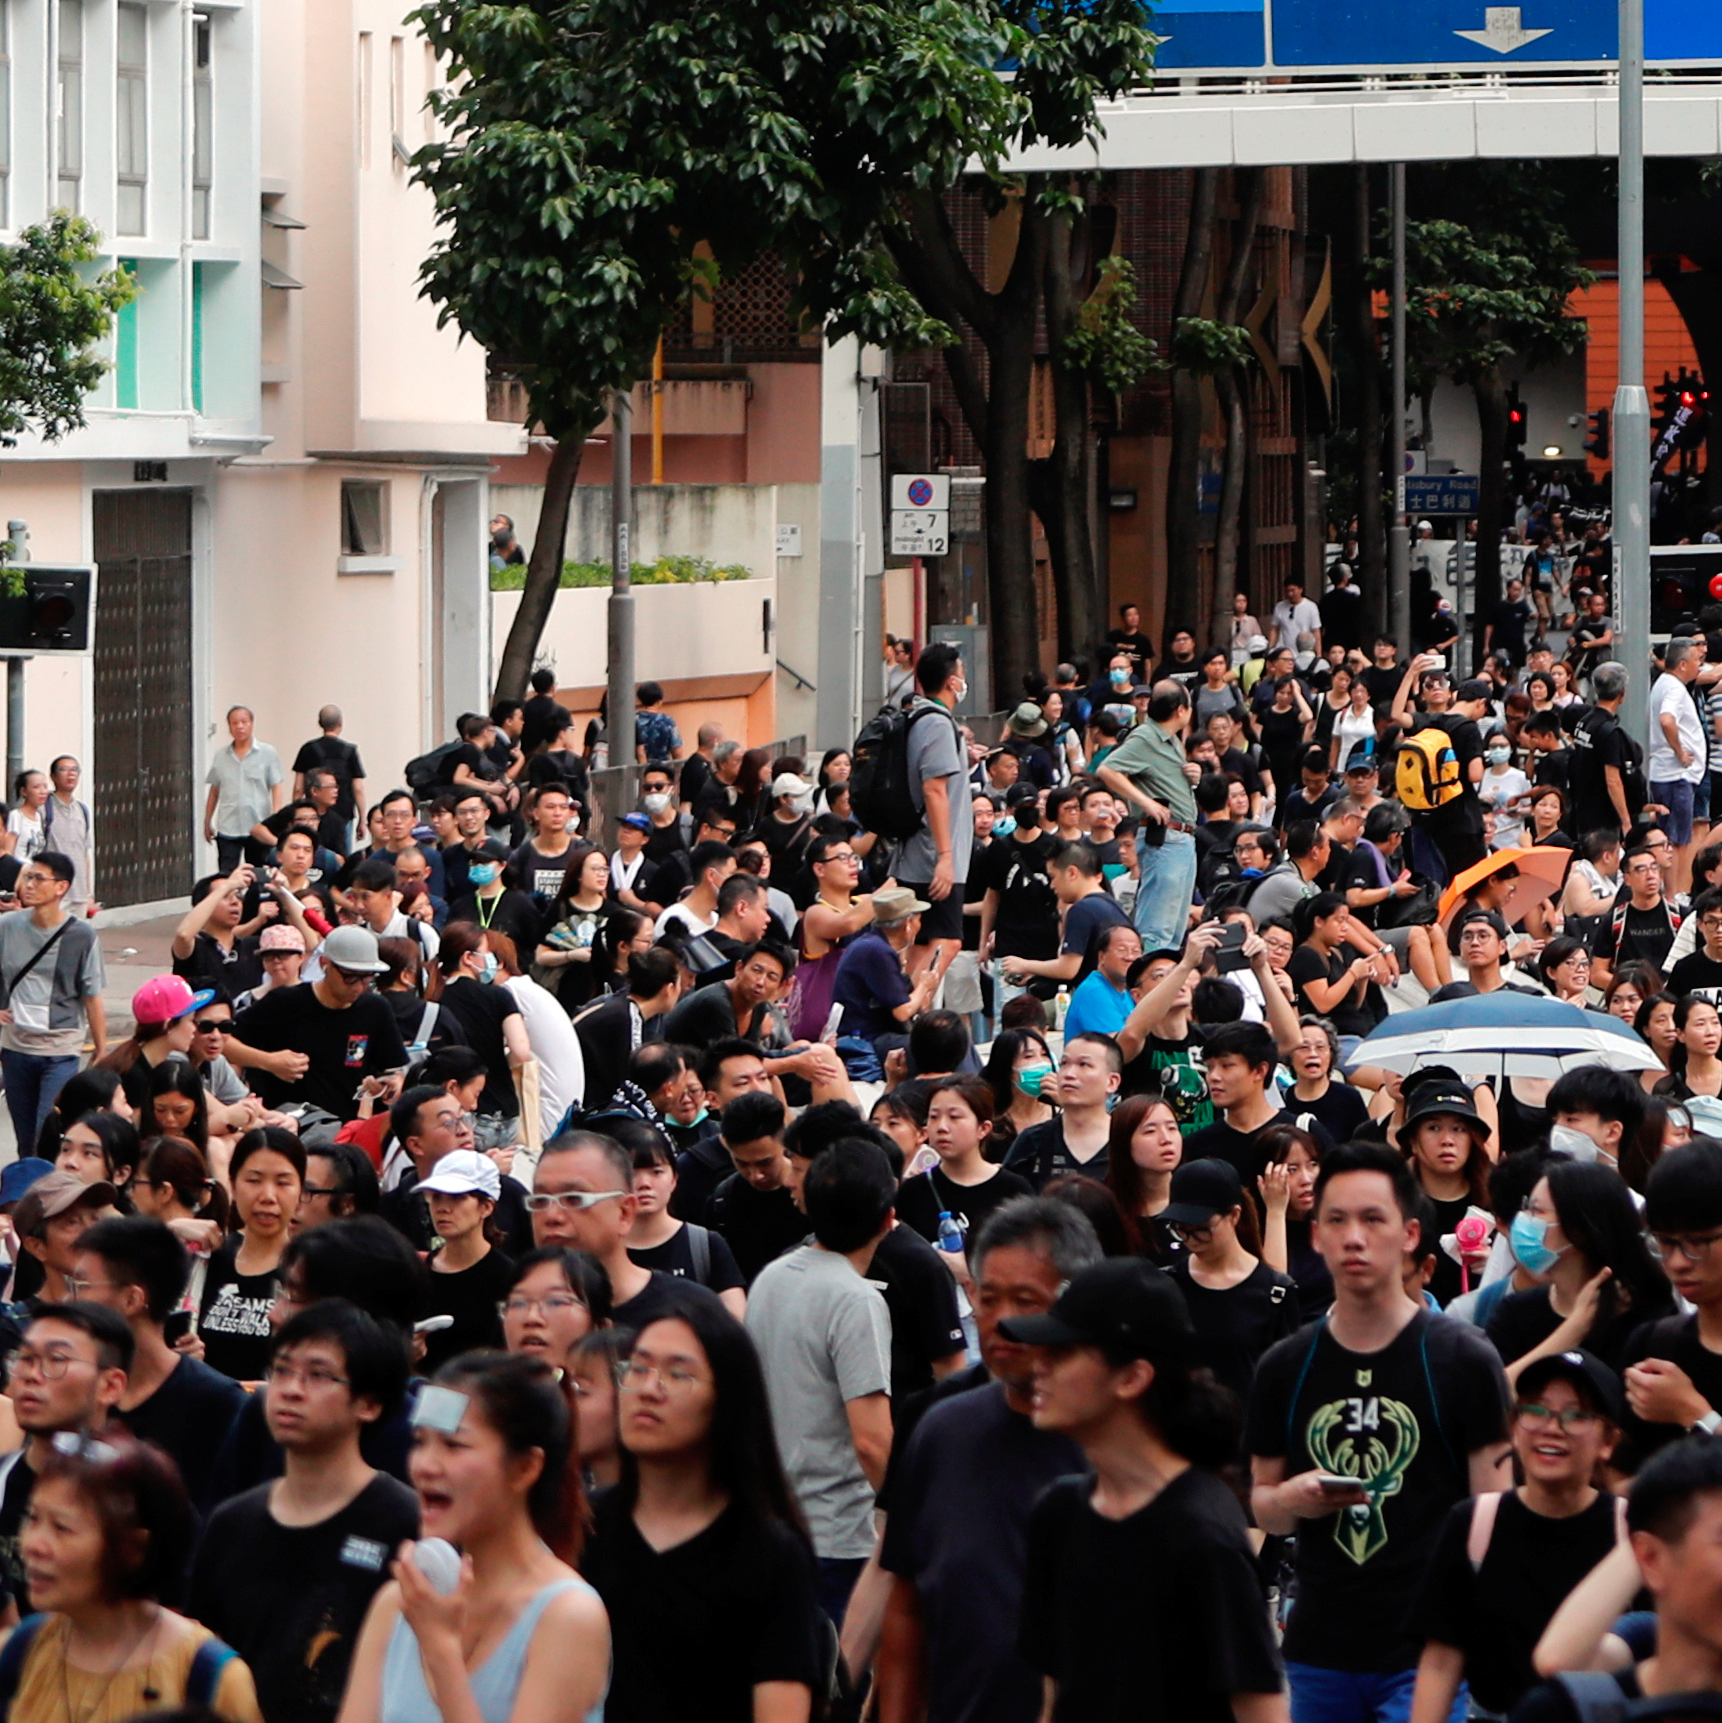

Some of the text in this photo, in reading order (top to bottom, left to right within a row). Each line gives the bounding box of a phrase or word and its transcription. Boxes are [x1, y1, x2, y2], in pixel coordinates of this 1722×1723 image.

[927, 514, 937, 528] 7
[928, 537, 945, 552] 12
[1345, 1397, 1380, 1431] 34
